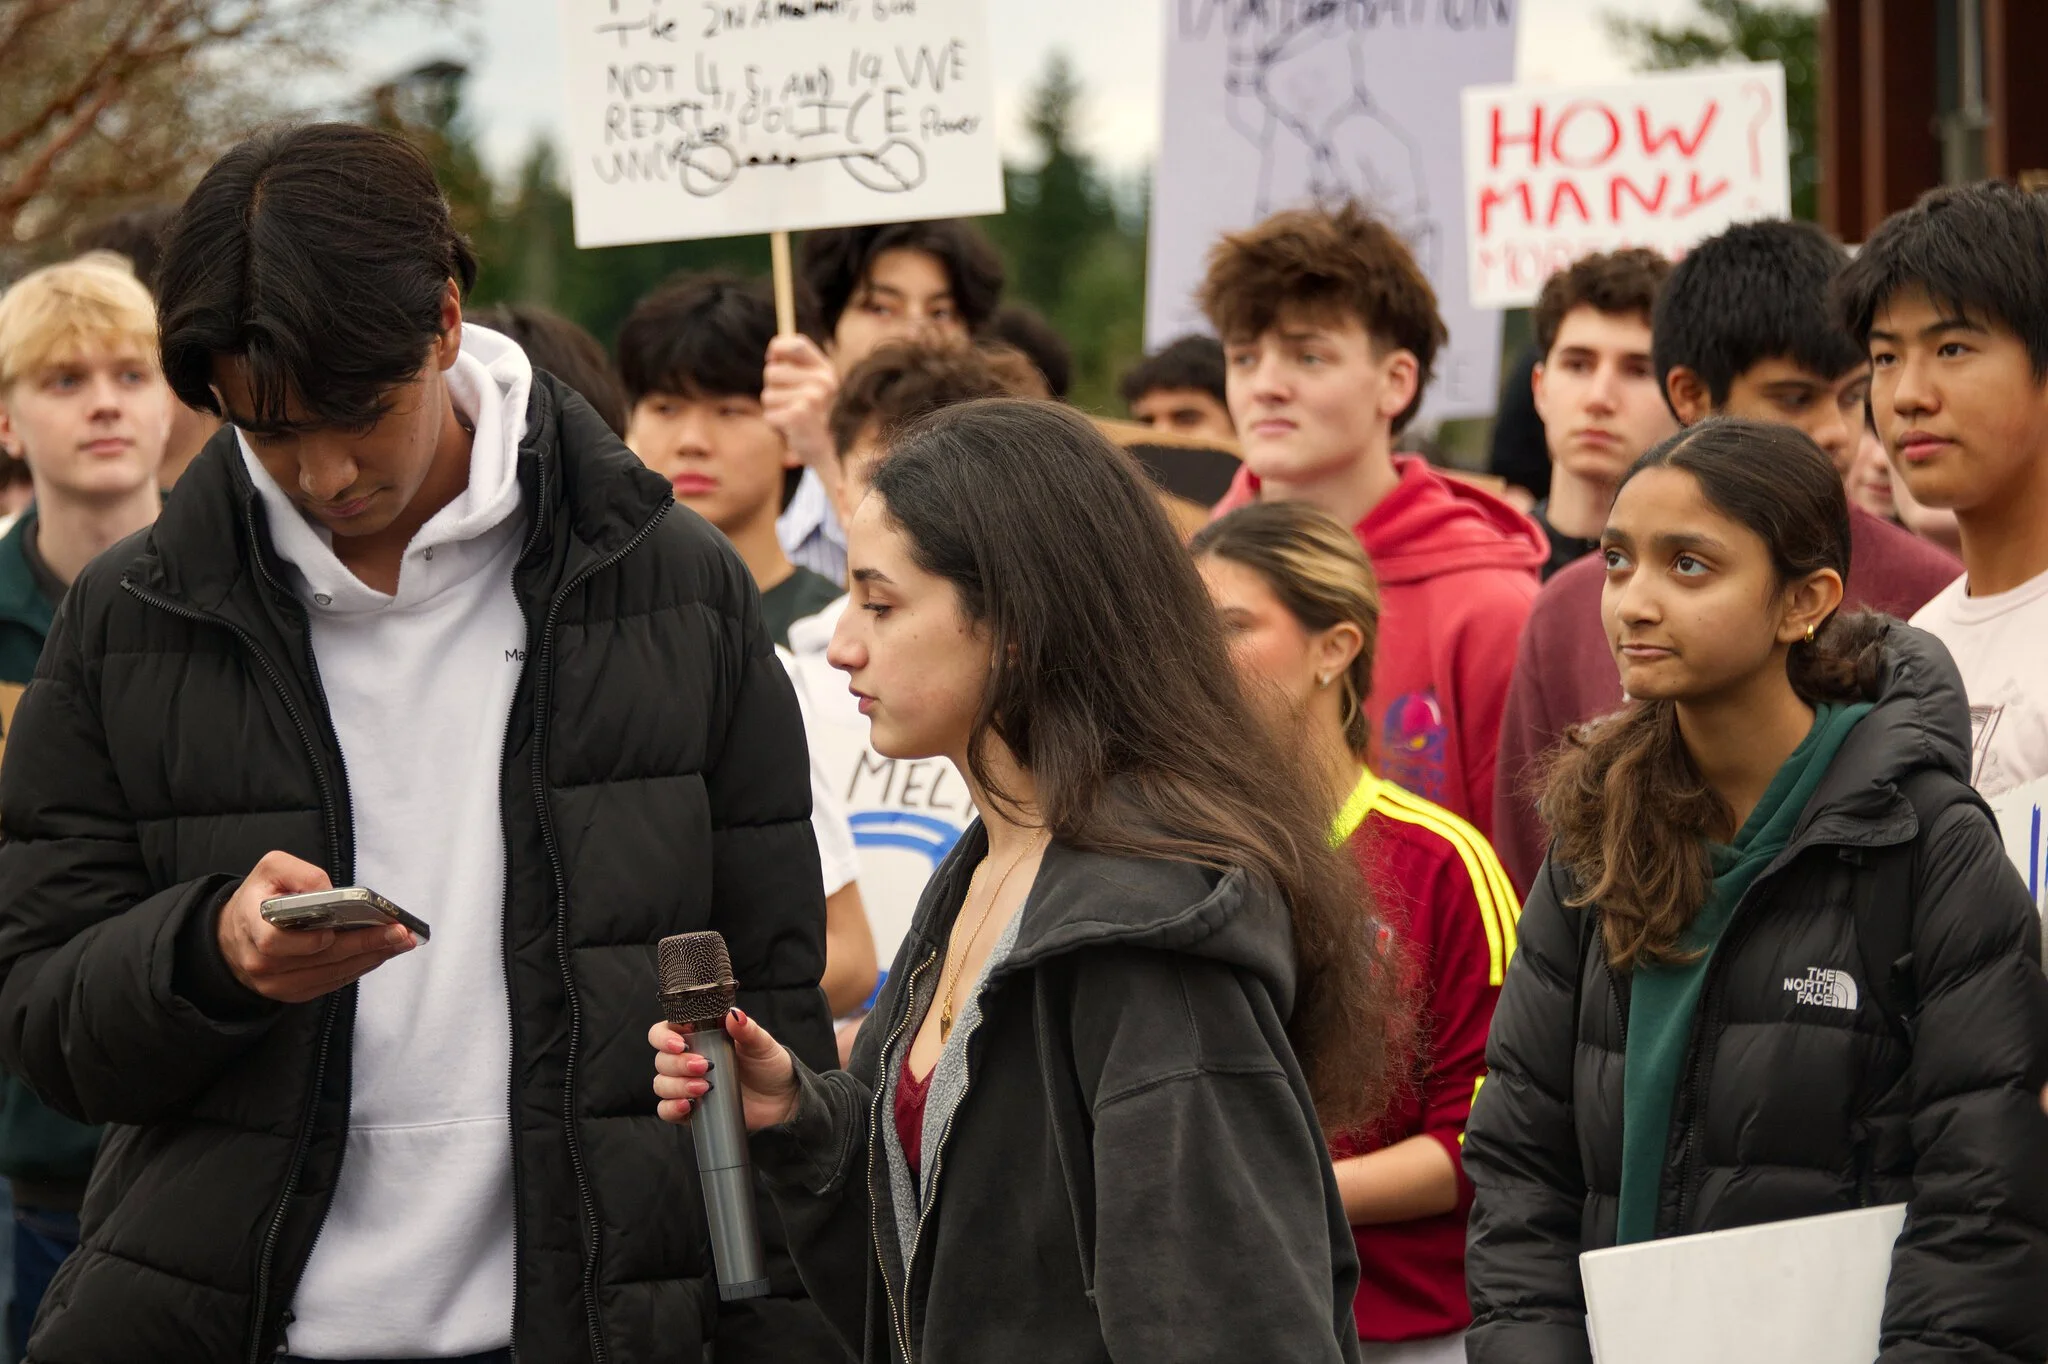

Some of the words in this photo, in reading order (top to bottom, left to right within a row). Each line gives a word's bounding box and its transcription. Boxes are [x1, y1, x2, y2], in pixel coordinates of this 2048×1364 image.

[607, 61, 676, 99] NOT
[895, 35, 965, 93] WE
[1488, 98, 1720, 170] HOW
[1477, 172, 1730, 236] MANY
[846, 749, 977, 820] MEL
[1783, 977, 1834, 995] NORTH
[1796, 990, 1833, 1007] FACE
[1807, 966, 1835, 982] THE
